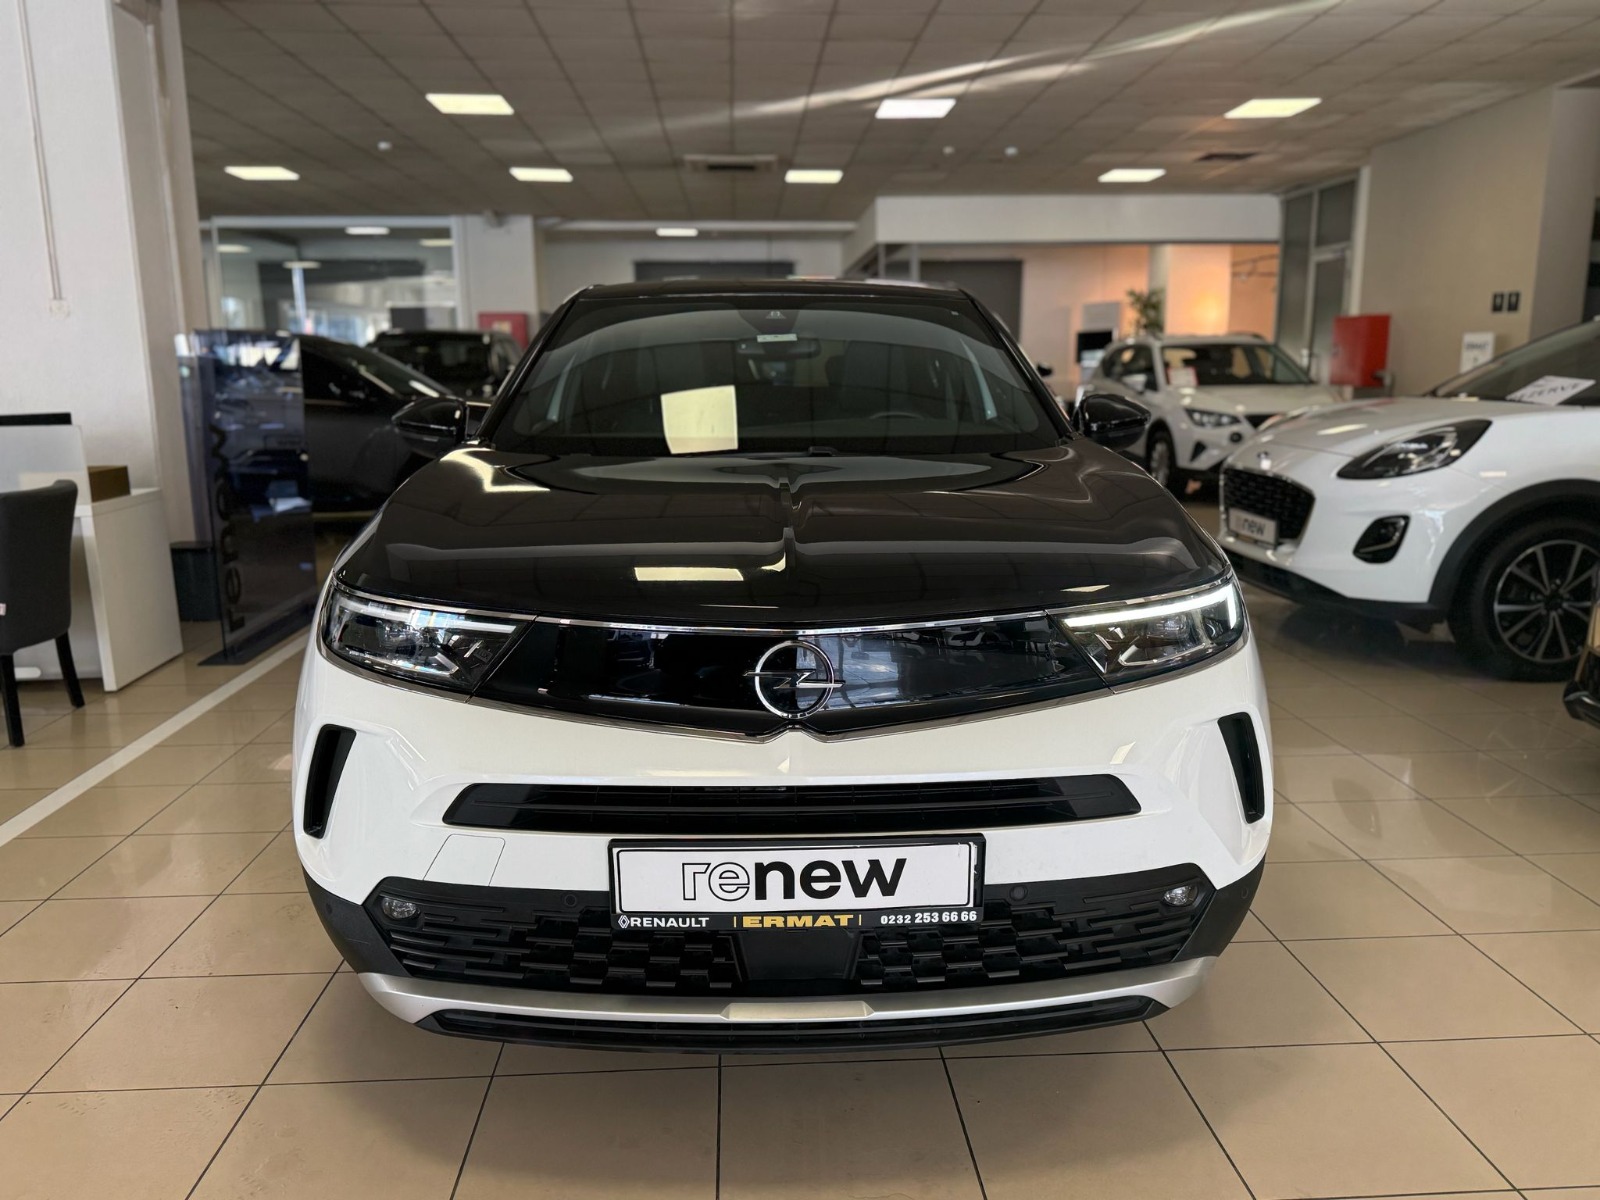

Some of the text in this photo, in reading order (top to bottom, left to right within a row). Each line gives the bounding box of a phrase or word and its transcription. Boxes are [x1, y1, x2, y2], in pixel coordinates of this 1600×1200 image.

[681, 858, 907, 902] renew
[630, 910, 977, 929] RENAULT ERMAT 0232 253 66 66
